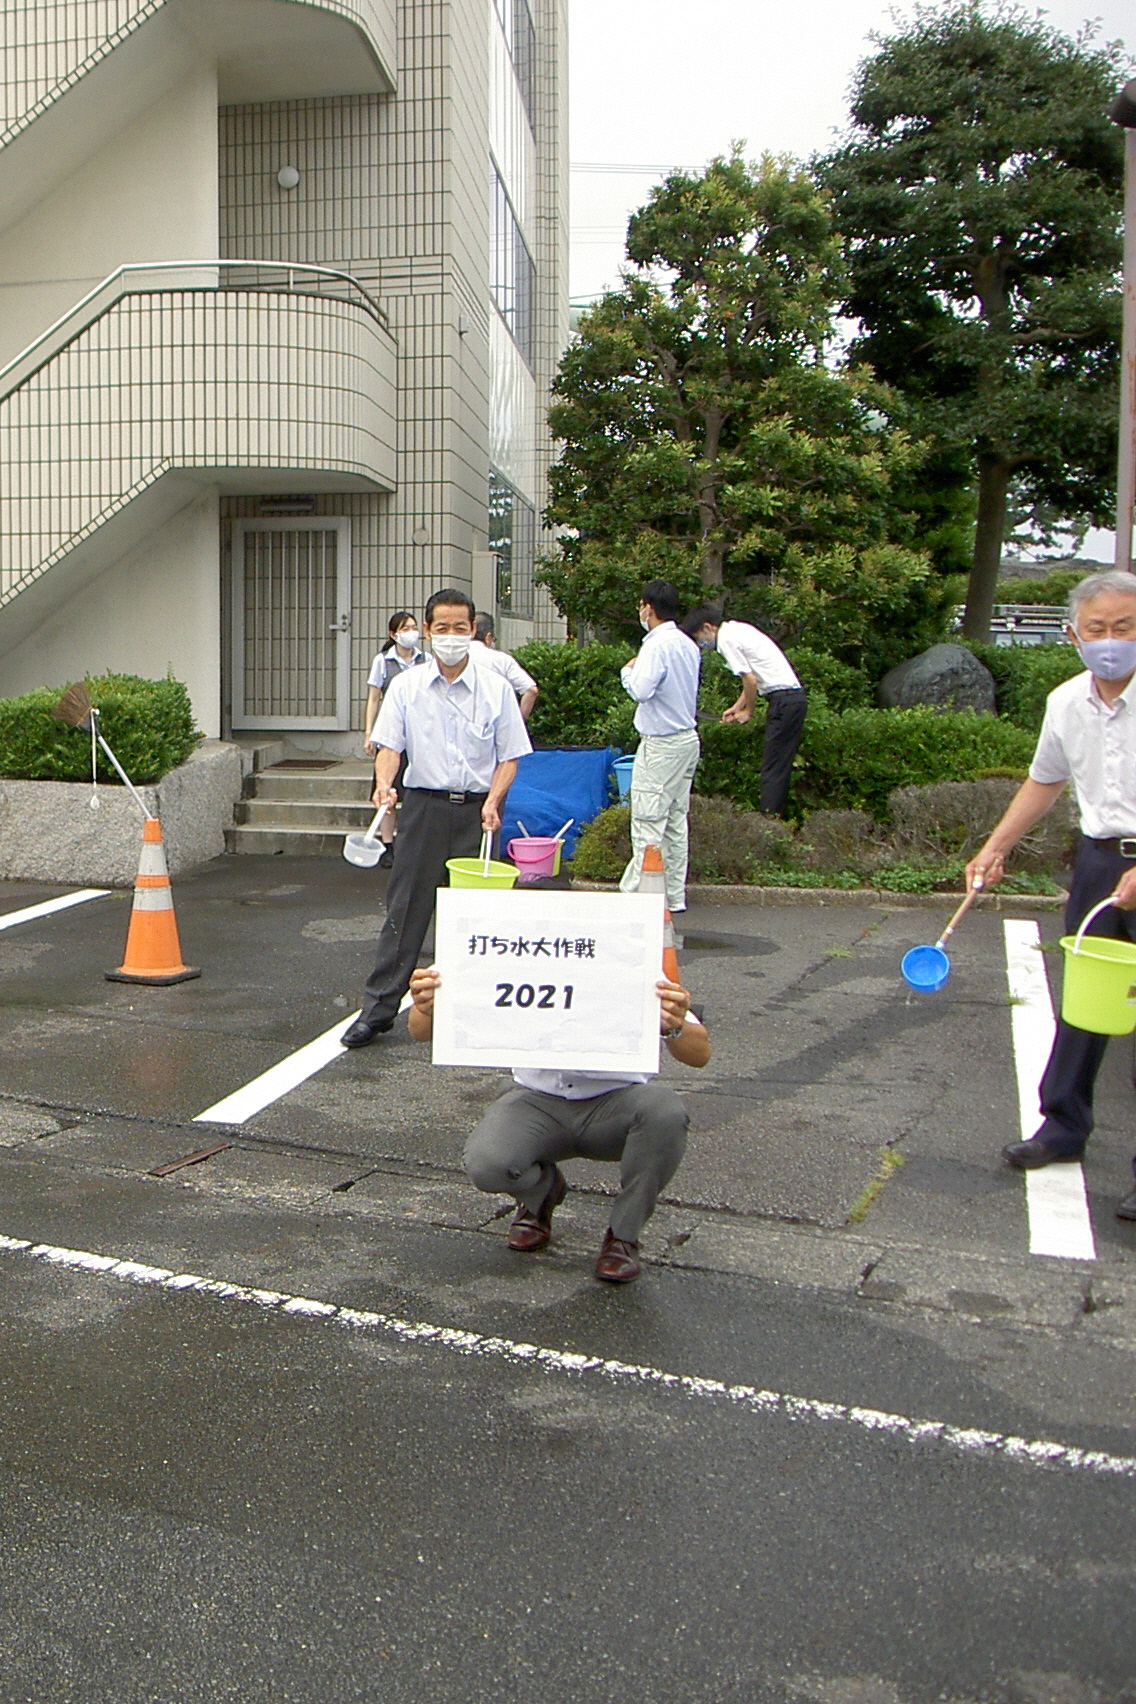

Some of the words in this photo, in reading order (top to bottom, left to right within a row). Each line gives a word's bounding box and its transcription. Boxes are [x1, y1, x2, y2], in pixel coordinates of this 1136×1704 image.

[468, 935, 596, 959] 打ち水大作戦
[494, 983, 574, 1010] 2021
